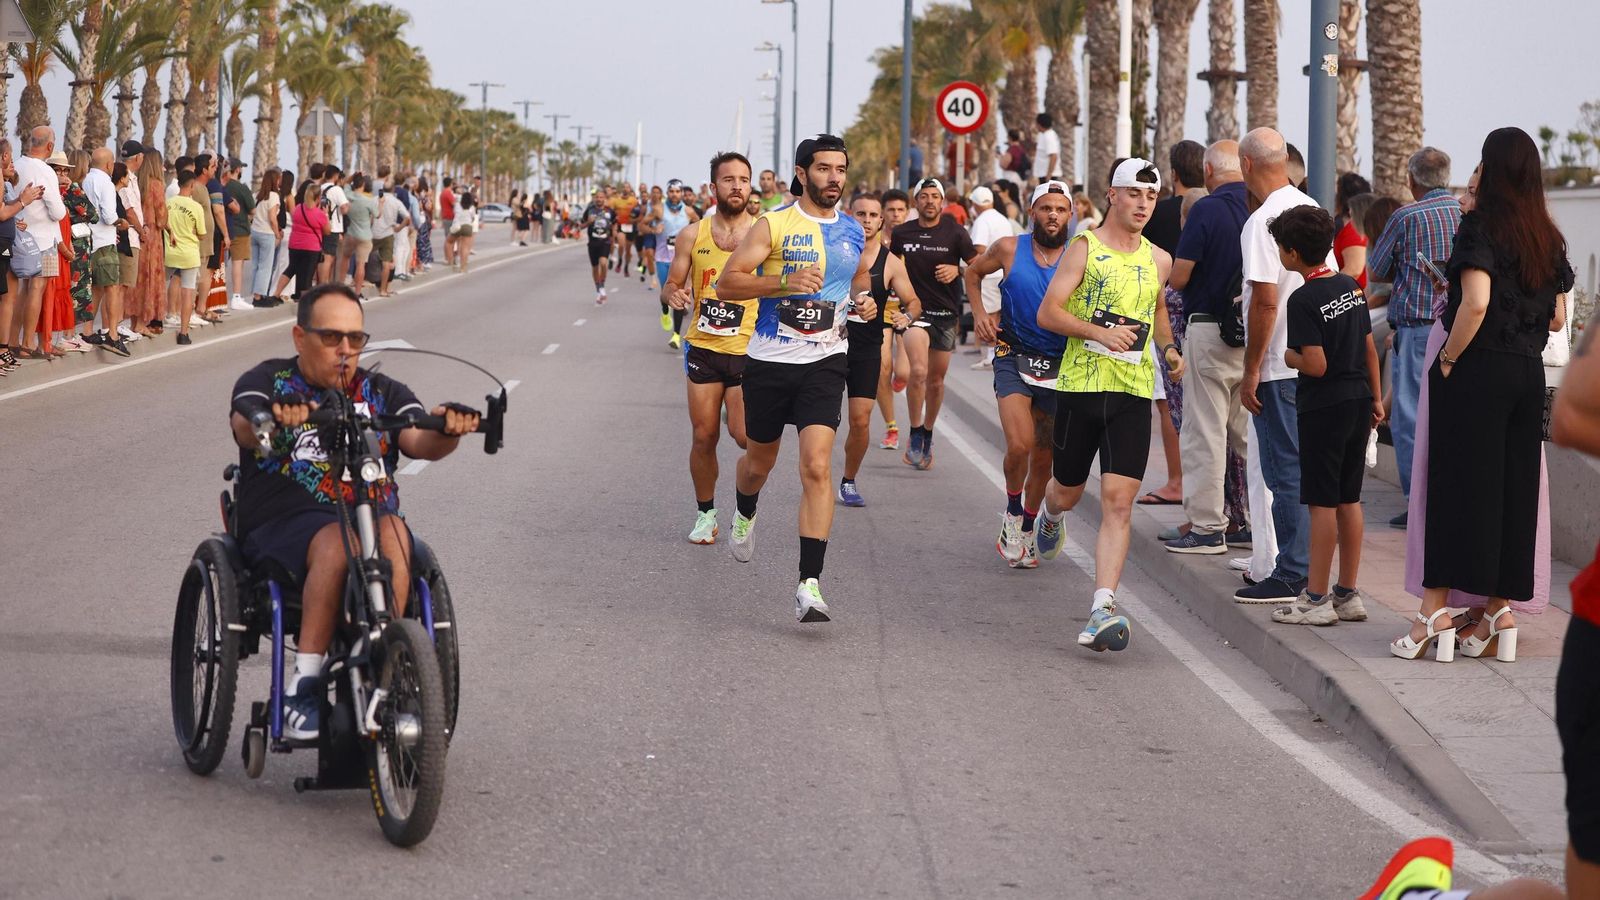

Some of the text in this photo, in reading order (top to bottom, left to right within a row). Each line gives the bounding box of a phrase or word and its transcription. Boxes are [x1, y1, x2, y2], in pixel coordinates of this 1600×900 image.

[947, 97, 975, 117] 40
[791, 233, 813, 247] CxM
[782, 248, 819, 263] Cañada
[706, 305, 736, 320] 1094
[796, 308, 822, 320] 291
[1028, 358, 1051, 370] 145
